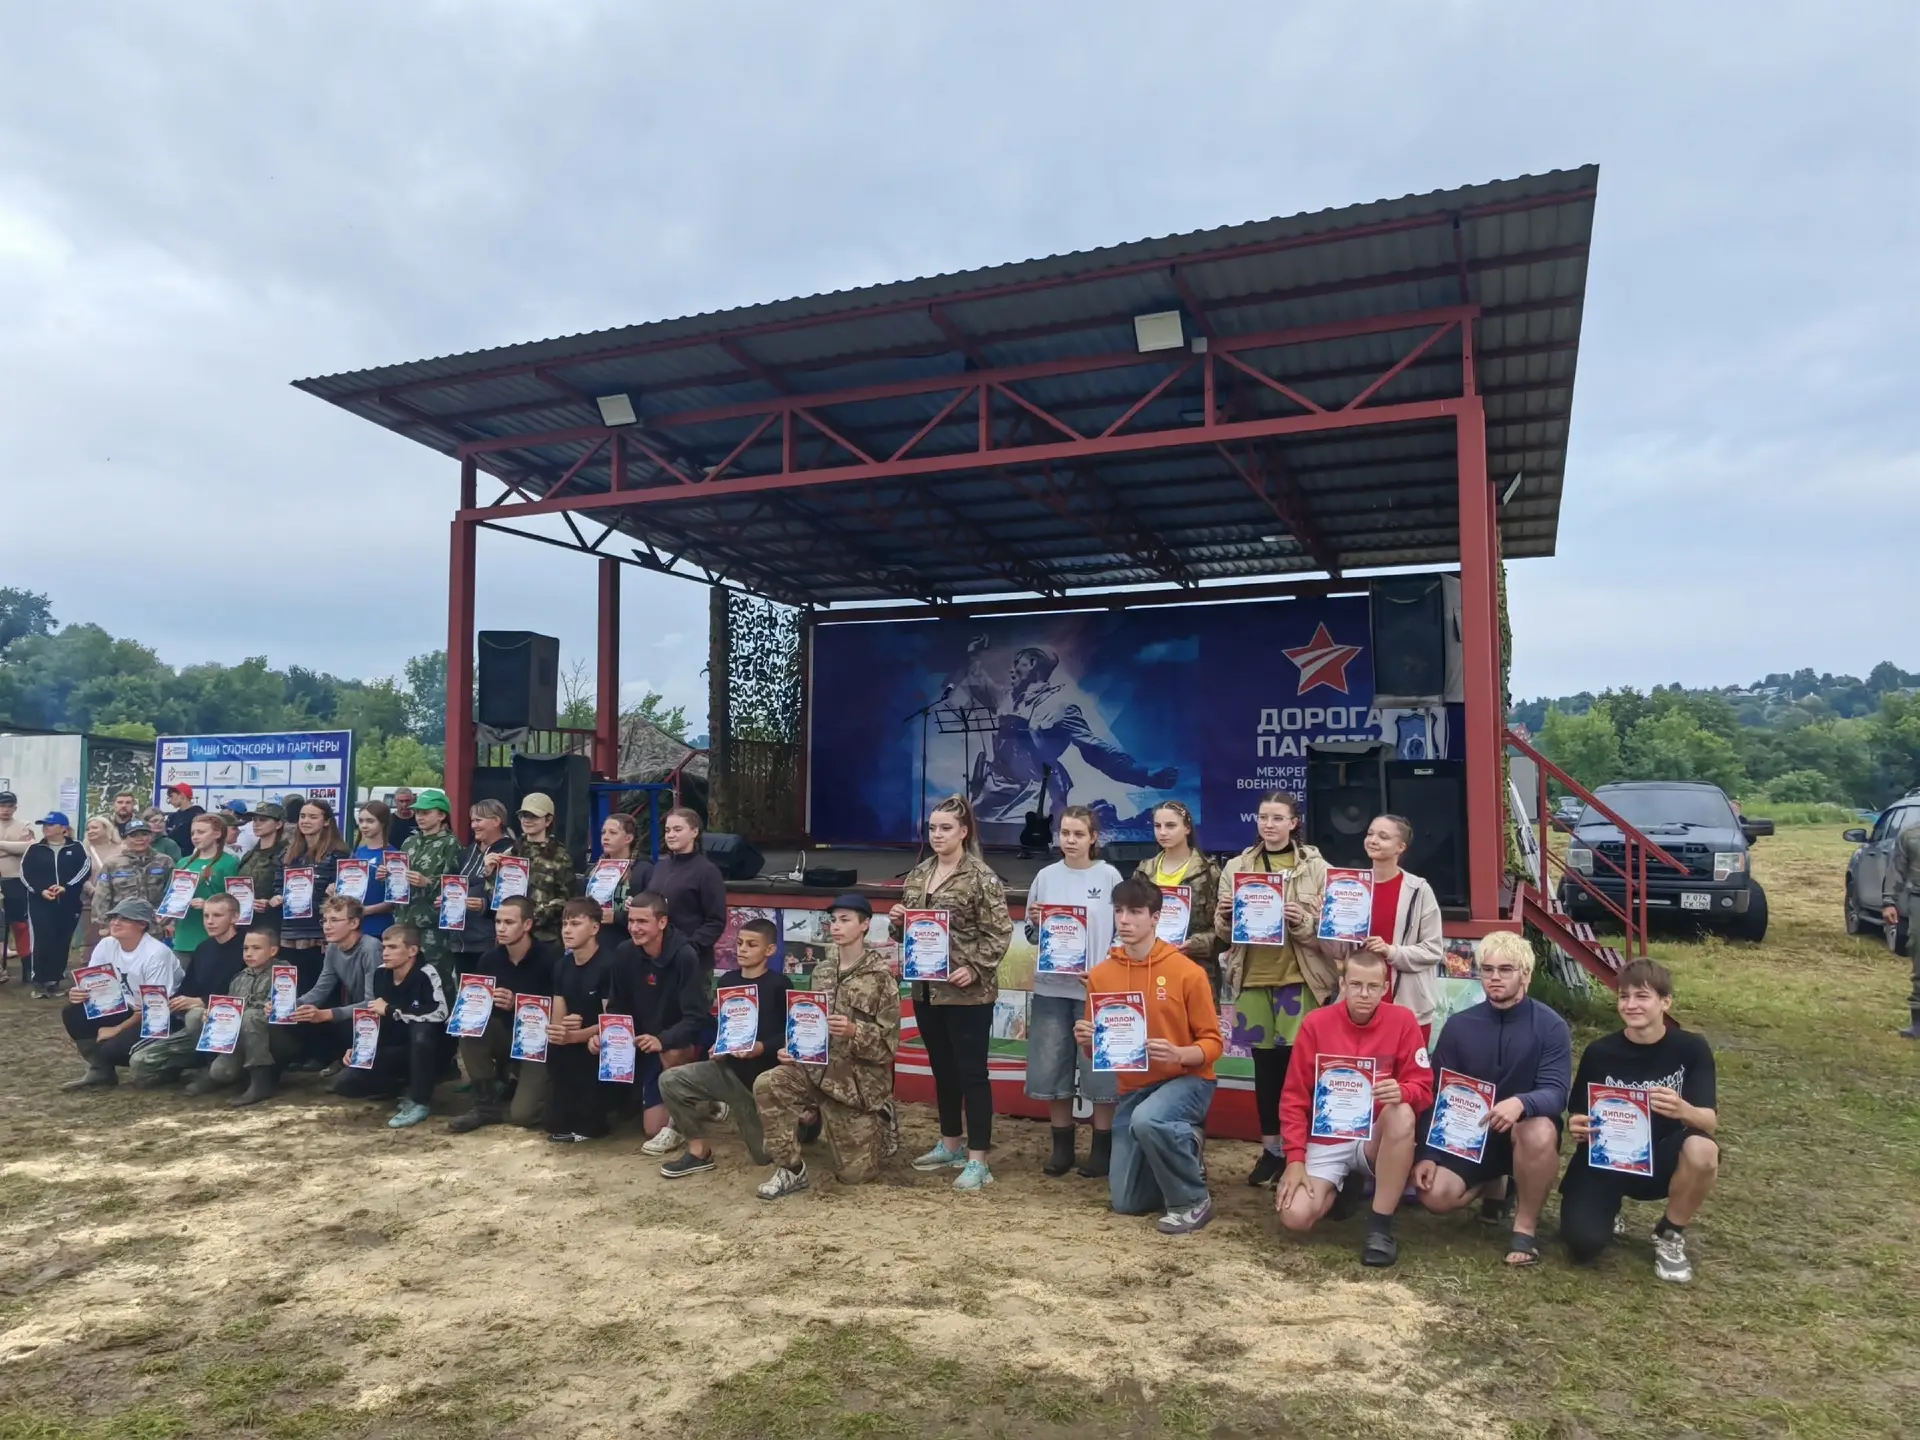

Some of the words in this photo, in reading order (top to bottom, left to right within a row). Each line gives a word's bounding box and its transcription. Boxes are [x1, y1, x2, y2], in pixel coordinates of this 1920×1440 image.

[1257, 706, 1382, 733] ДОРОГА
[192, 744, 220, 756] НАШИ
[222, 742, 274, 755] СПОНСОРЫ
[277, 743, 285, 754] И
[287, 740, 339, 753] ПАРТНЁРЫ
[1104, 1016, 1135, 1024] ДИПЛОМ
[1329, 1080, 1363, 1088] ДИПЛОМ
[1448, 1095, 1482, 1110] ДИПЛОМ
[1602, 1110, 1638, 1120] ДИПЛОМ
